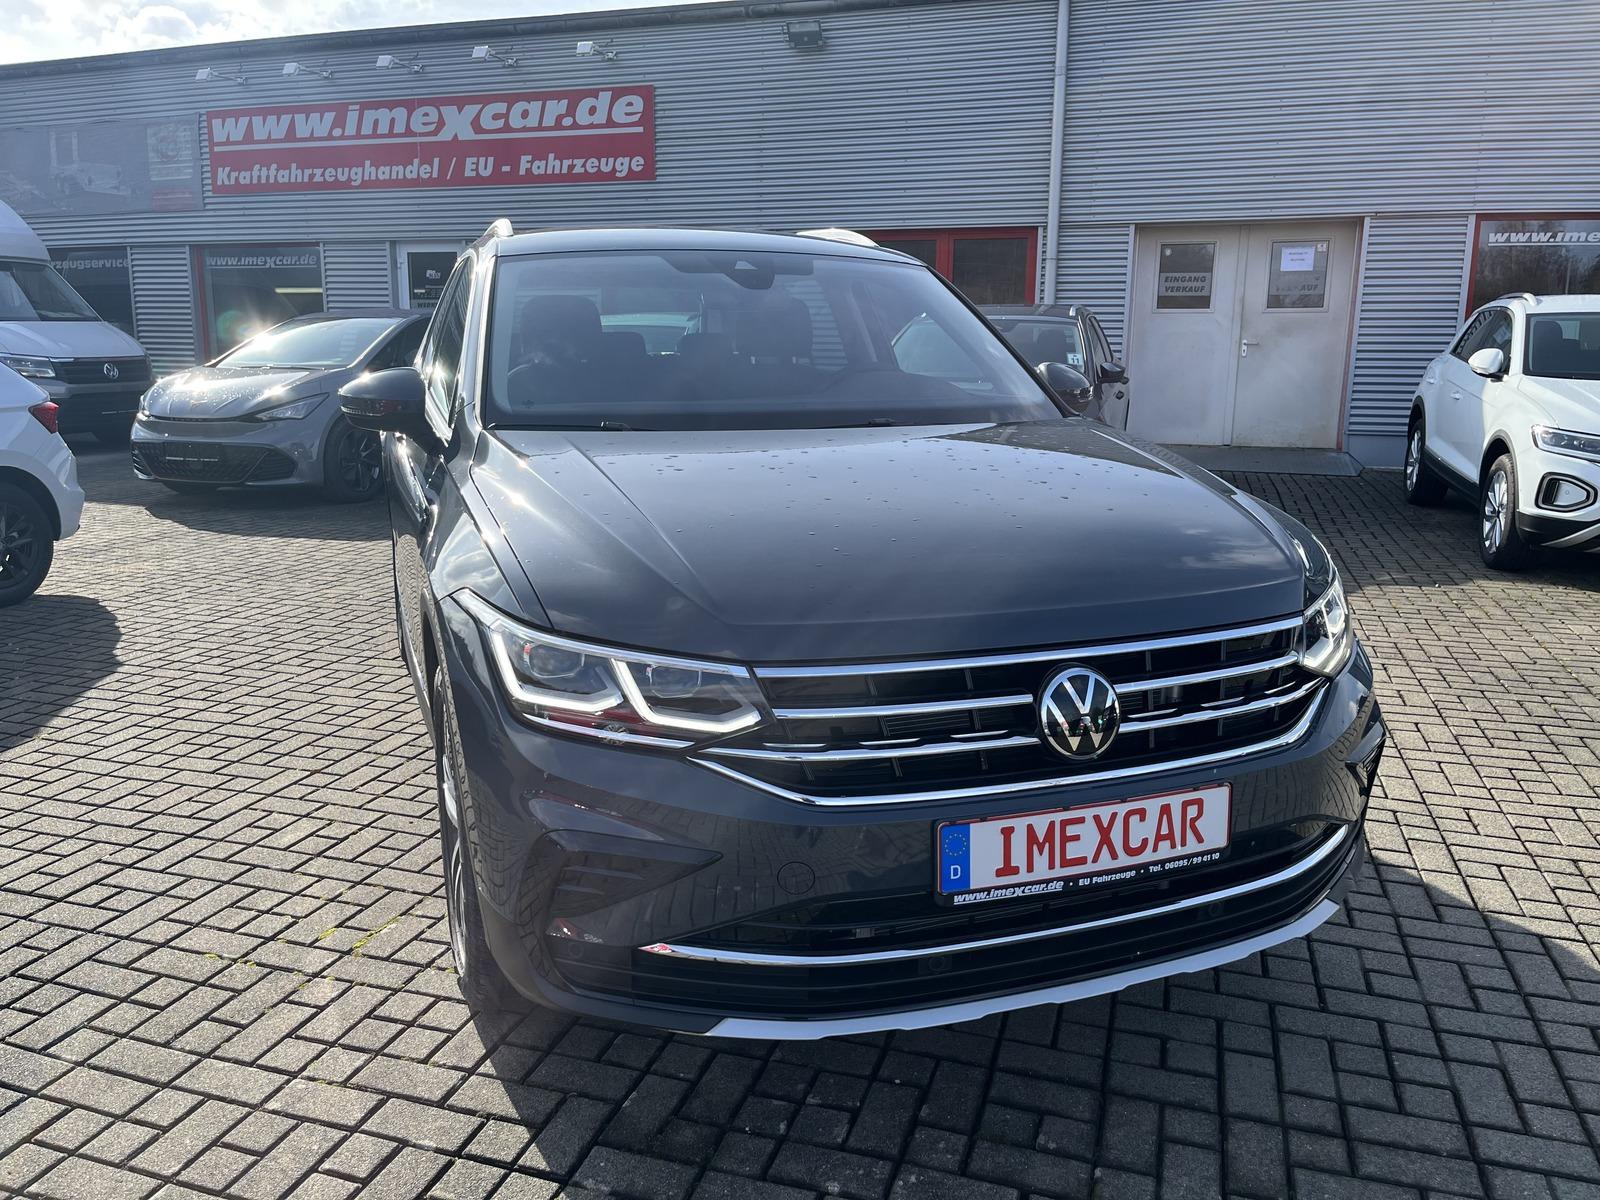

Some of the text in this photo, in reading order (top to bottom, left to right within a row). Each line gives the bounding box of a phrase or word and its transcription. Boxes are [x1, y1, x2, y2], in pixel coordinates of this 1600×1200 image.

[211, 91, 644, 142] www.imexcar.de
[217, 157, 440, 186] Kraftfahrzeughandel
[446, 157, 456, 180] /
[464, 156, 495, 177] EU
[519, 153, 645, 178] Fahrzeuge
[206, 254, 317, 268] www.imexcar.de
[1164, 275, 1207, 283] EINGANG
[1164, 285, 1206, 293] VERKAUF
[995, 797, 1205, 878] IMEXCAR
[950, 865, 961, 880] D
[953, 880, 1064, 904] www.imexcar.de
[1078, 878, 1091, 886] EU
[1092, 870, 1137, 884] Fahrzeuge
[1149, 863, 1163, 873] Tel.
